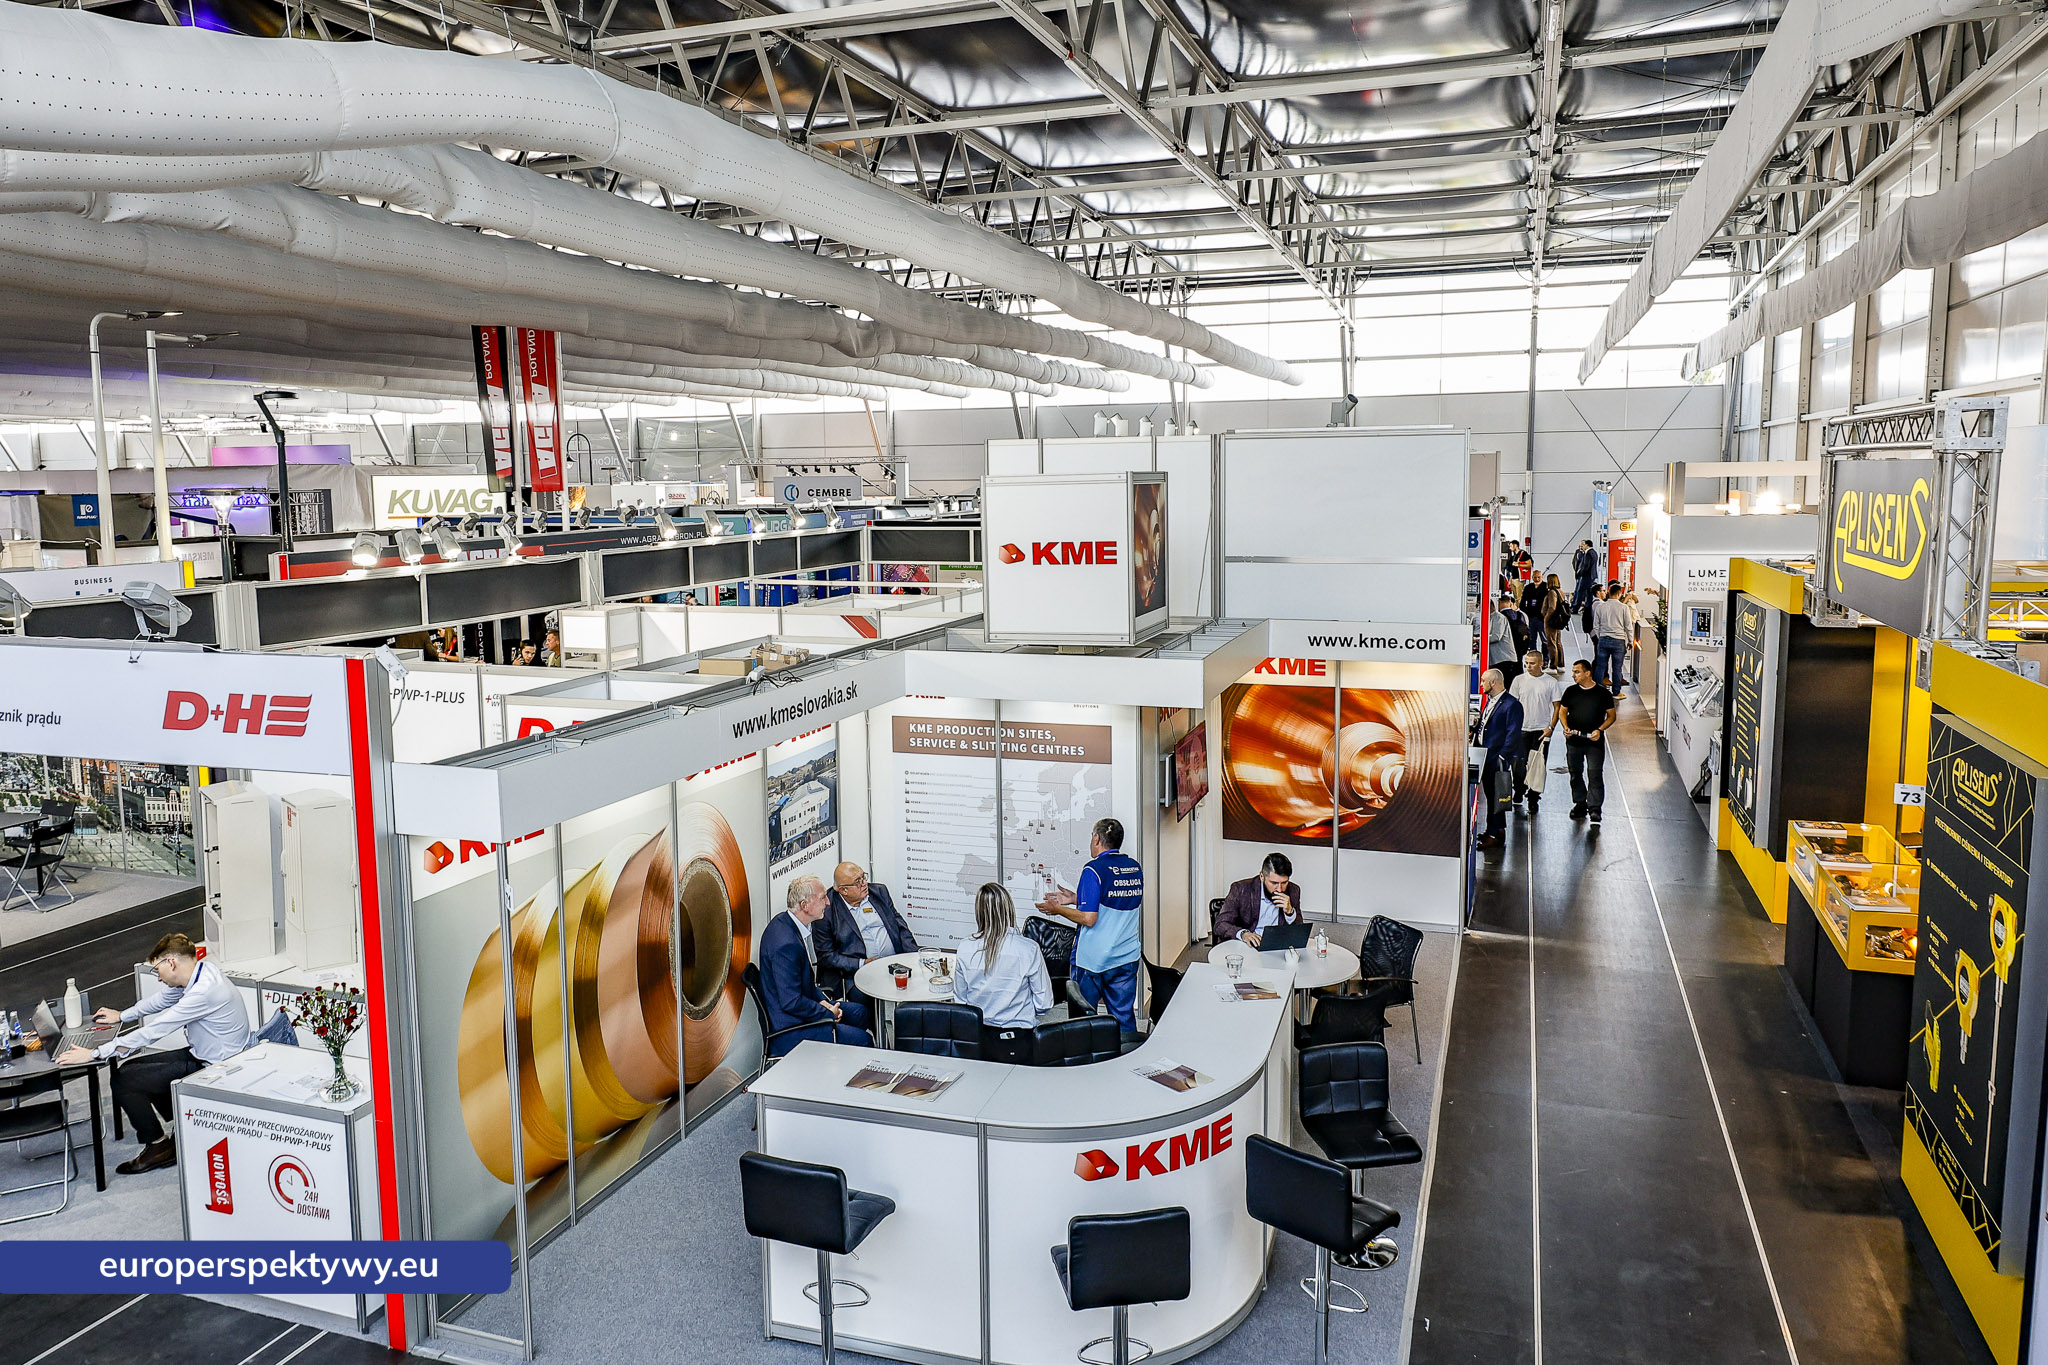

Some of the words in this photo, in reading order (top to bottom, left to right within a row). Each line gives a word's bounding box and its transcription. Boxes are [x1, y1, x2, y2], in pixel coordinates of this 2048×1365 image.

[388, 488, 492, 514] KUVAG
[807, 488, 851, 497] CEMBRE
[1833, 477, 1930, 593] APLISENS
[1031, 541, 1118, 566] KME
[74, 576, 113, 586] BUSINESS
[1308, 633, 1447, 652] www.kme.com
[26, 712, 61, 728] prądu
[732, 680, 858, 739] www.kmeslovakia.sk
[909, 723, 933, 734] KME
[936, 724, 1015, 738] PRODUCTION
[1018, 728, 1056, 742] SITES,
[909, 737, 956, 749] SERVICE
[959, 740, 968, 750] &
[971, 740, 1028, 753] SLITTING
[1030, 743, 1085, 756] CENTRES
[1900, 791, 1922, 804] 73
[771, 837, 835, 880] www.kmeslovakia.sk
[193, 1117, 235, 1134] WYŁĄCZNIK
[237, 1126, 263, 1139] PRĄDU
[270, 1134, 332, 1152] DH-PWP-1-PLUS
[194, 1108, 256, 1127] CERTYFIKOWANY
[257, 1120, 334, 1142] PRZECIWPOŻAROWY
[1126, 1112, 1233, 1182] KME
[212, 1153, 230, 1206] NOWOŚĆ
[304, 1190, 319, 1203] 24H
[296, 1203, 330, 1221] DOSTAWA
